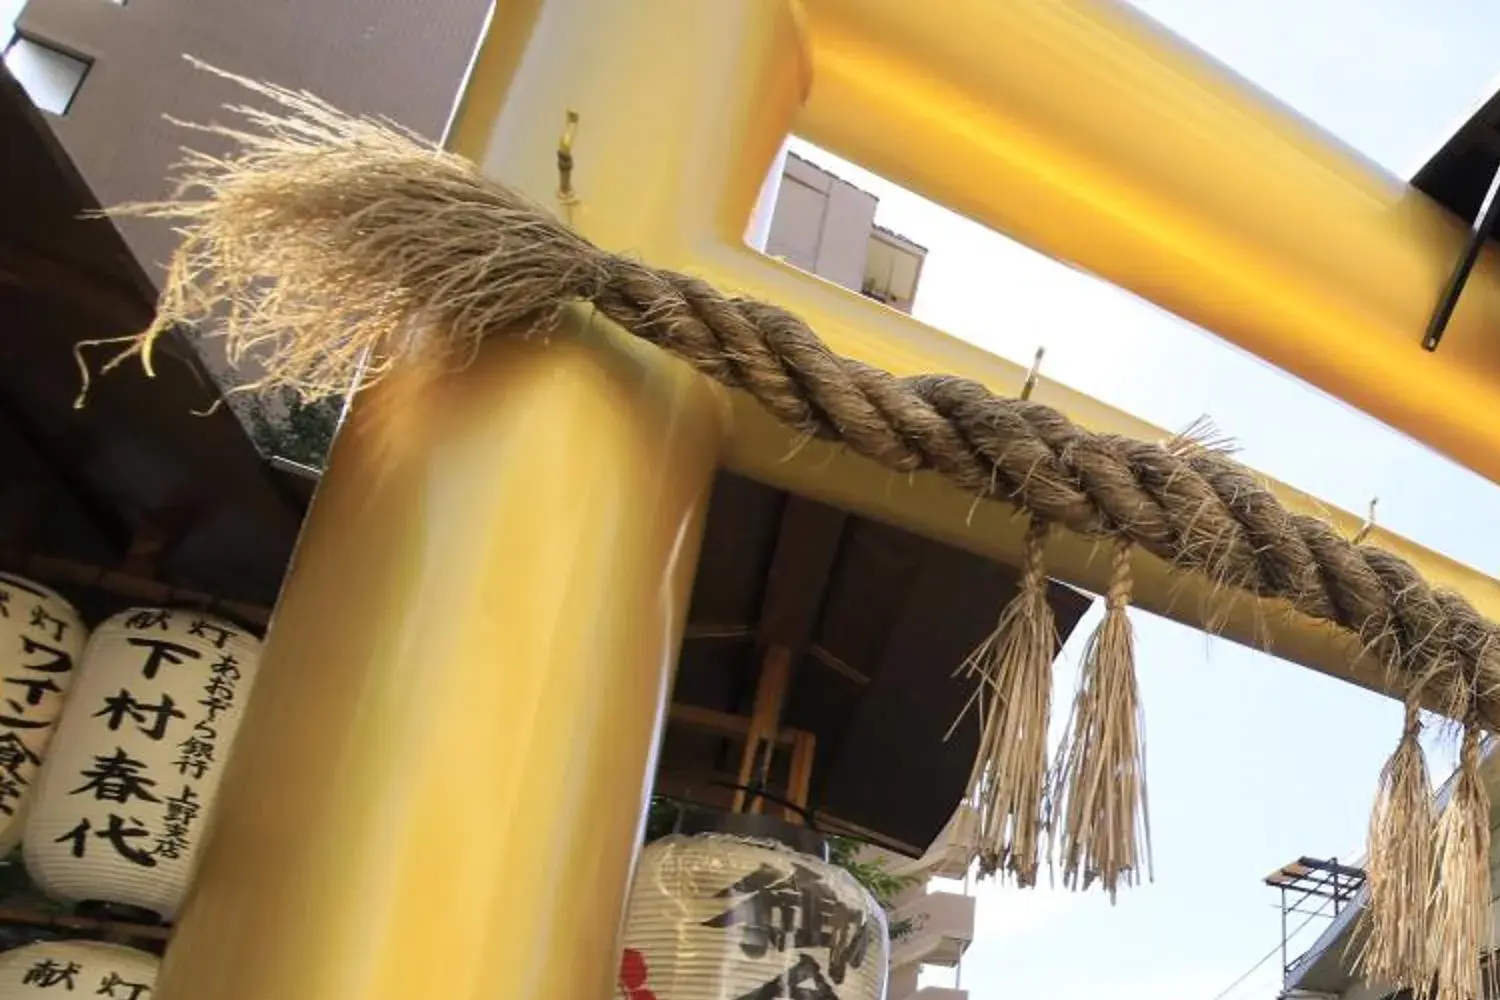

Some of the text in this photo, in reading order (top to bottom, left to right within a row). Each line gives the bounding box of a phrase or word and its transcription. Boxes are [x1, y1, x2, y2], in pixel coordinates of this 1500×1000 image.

[125, 609, 239, 648] 献灯
[55, 637, 202, 867] 下村春代
[170, 654, 242, 781] あおぞら銀行
